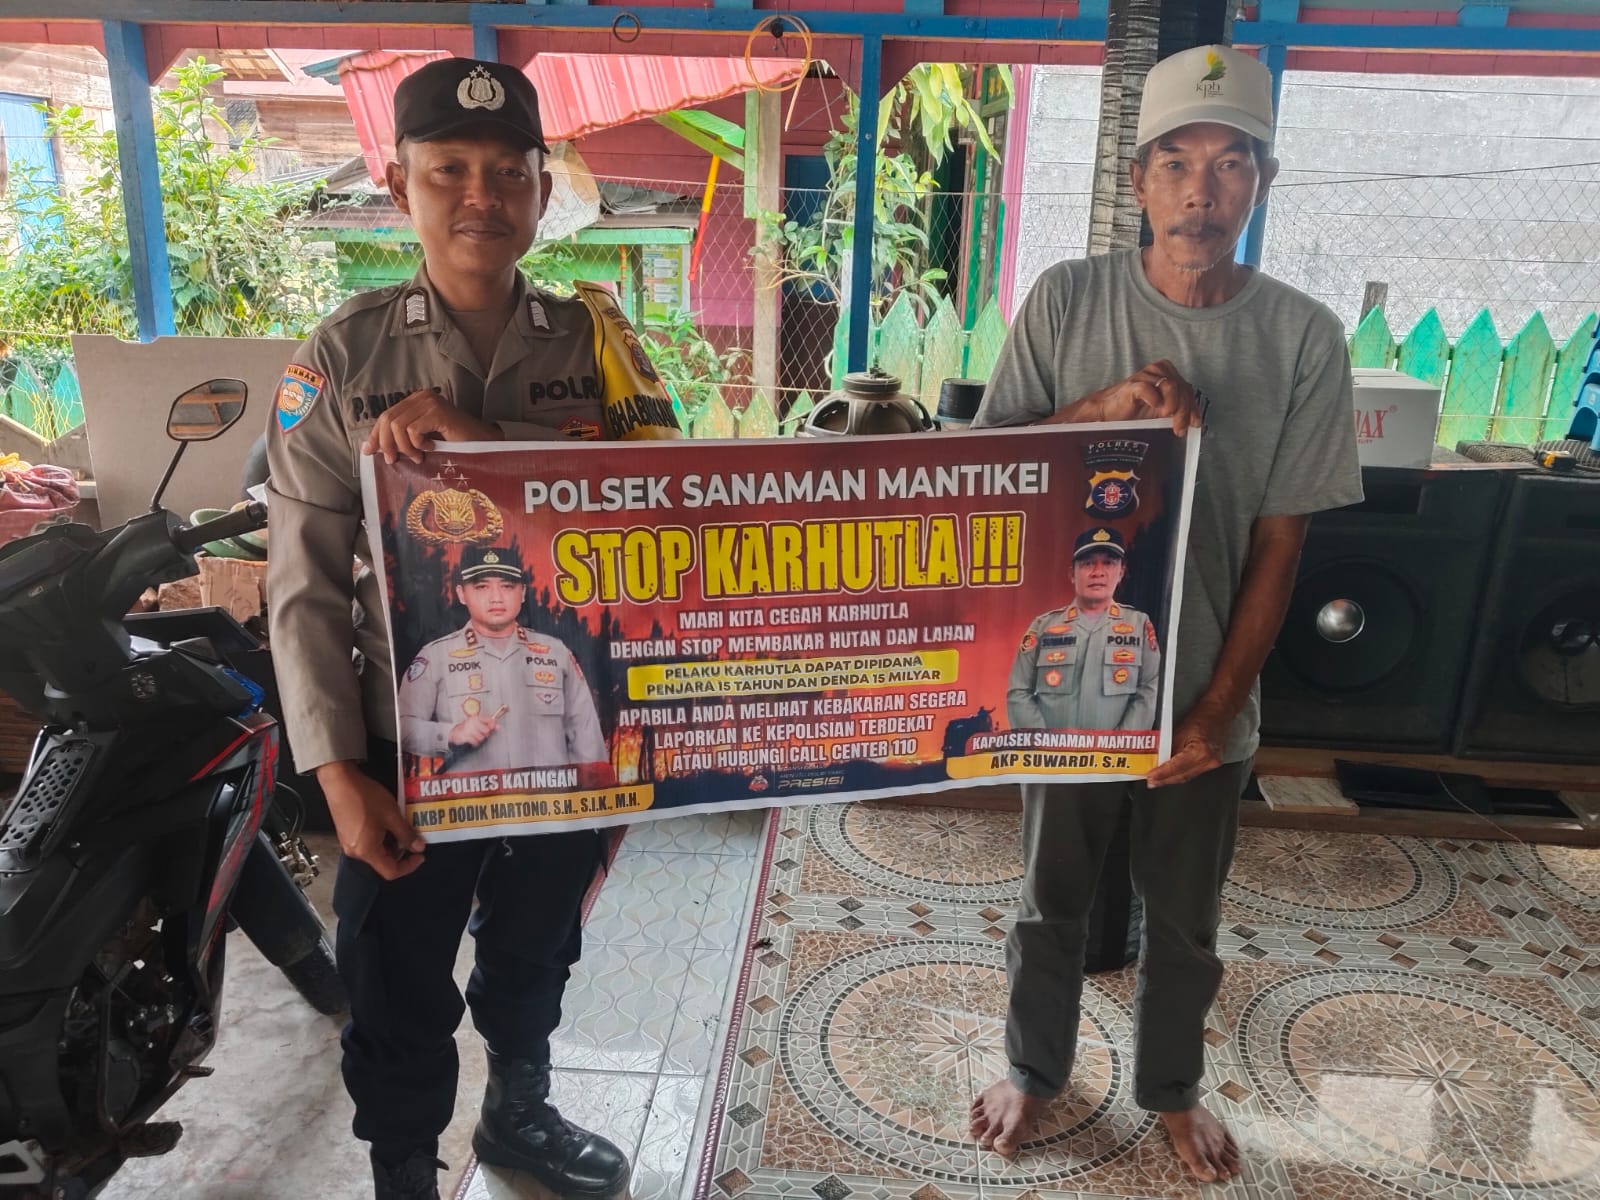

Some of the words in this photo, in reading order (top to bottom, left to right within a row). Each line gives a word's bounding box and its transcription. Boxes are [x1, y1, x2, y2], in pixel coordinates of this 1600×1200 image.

[523, 475, 674, 514] POLSEK
[681, 468, 866, 508] SANAMAN
[877, 462, 1050, 500] MANTIKEI
[554, 526, 694, 605] STOP
[702, 517, 962, 598] KARHUTLA
[970, 514, 1023, 586] !!!
[679, 611, 723, 630] MARI
[729, 609, 764, 628] KITA
[769, 606, 822, 626] CEGAH
[827, 602, 909, 622] KARHUTLA
[610, 639, 676, 659] DENGAN
[681, 638, 723, 656] STOP
[728, 632, 825, 653] MEMBAKAR
[829, 629, 881, 649] HUTAN
[886, 627, 918, 645] DAN
[922, 624, 976, 643] LAHAN
[1107, 635, 1140, 647] POLRI
[448, 661, 482, 673] DODIK
[525, 656, 558, 667] POLRI
[664, 664, 721, 680] PELAKU
[724, 662, 803, 678] KARHUTLA
[804, 660, 852, 674] DAPAT
[853, 655, 924, 671] DIPIDANA
[646, 681, 716, 696] PENJARA
[717, 681, 731, 692] 15
[734, 679, 785, 692] TAHUN
[787, 676, 818, 689] DAN
[820, 673, 870, 687] DENDA
[872, 673, 886, 684] 15
[888, 669, 942, 683] MILYAR
[618, 707, 687, 727] APABILA
[691, 704, 736, 724] ANDA
[740, 700, 810, 720] MELIHAT
[813, 695, 904, 716] KEBAKARAN
[909, 690, 967, 710] SEGERA
[654, 727, 738, 750] LAPORKAN
[742, 725, 761, 743] KE
[766, 720, 855, 742] KEPOLISIAN
[859, 715, 936, 735] TERDEKAT
[972, 732, 1032, 750] KAPOLSEK
[1033, 732, 1095, 749] SANAMAN
[1097, 735, 1156, 750] MANTIKEI
[672, 752, 713, 772] ATAU
[717, 747, 785, 768] HUBUNGI
[789, 745, 827, 762] CALL
[831, 740, 889, 760] CENTER
[893, 738, 917, 755] 110
[990, 754, 1019, 769] AKP
[1102, 755, 1131, 769] S.H.
[419, 774, 499, 797] KAPOLRES
[502, 768, 578, 790] KATINGAN
[412, 809, 446, 828] AKBP
[450, 804, 488, 824] DODIK
[491, 801, 551, 819] HARTONO,
[615, 791, 641, 809] M.H.
